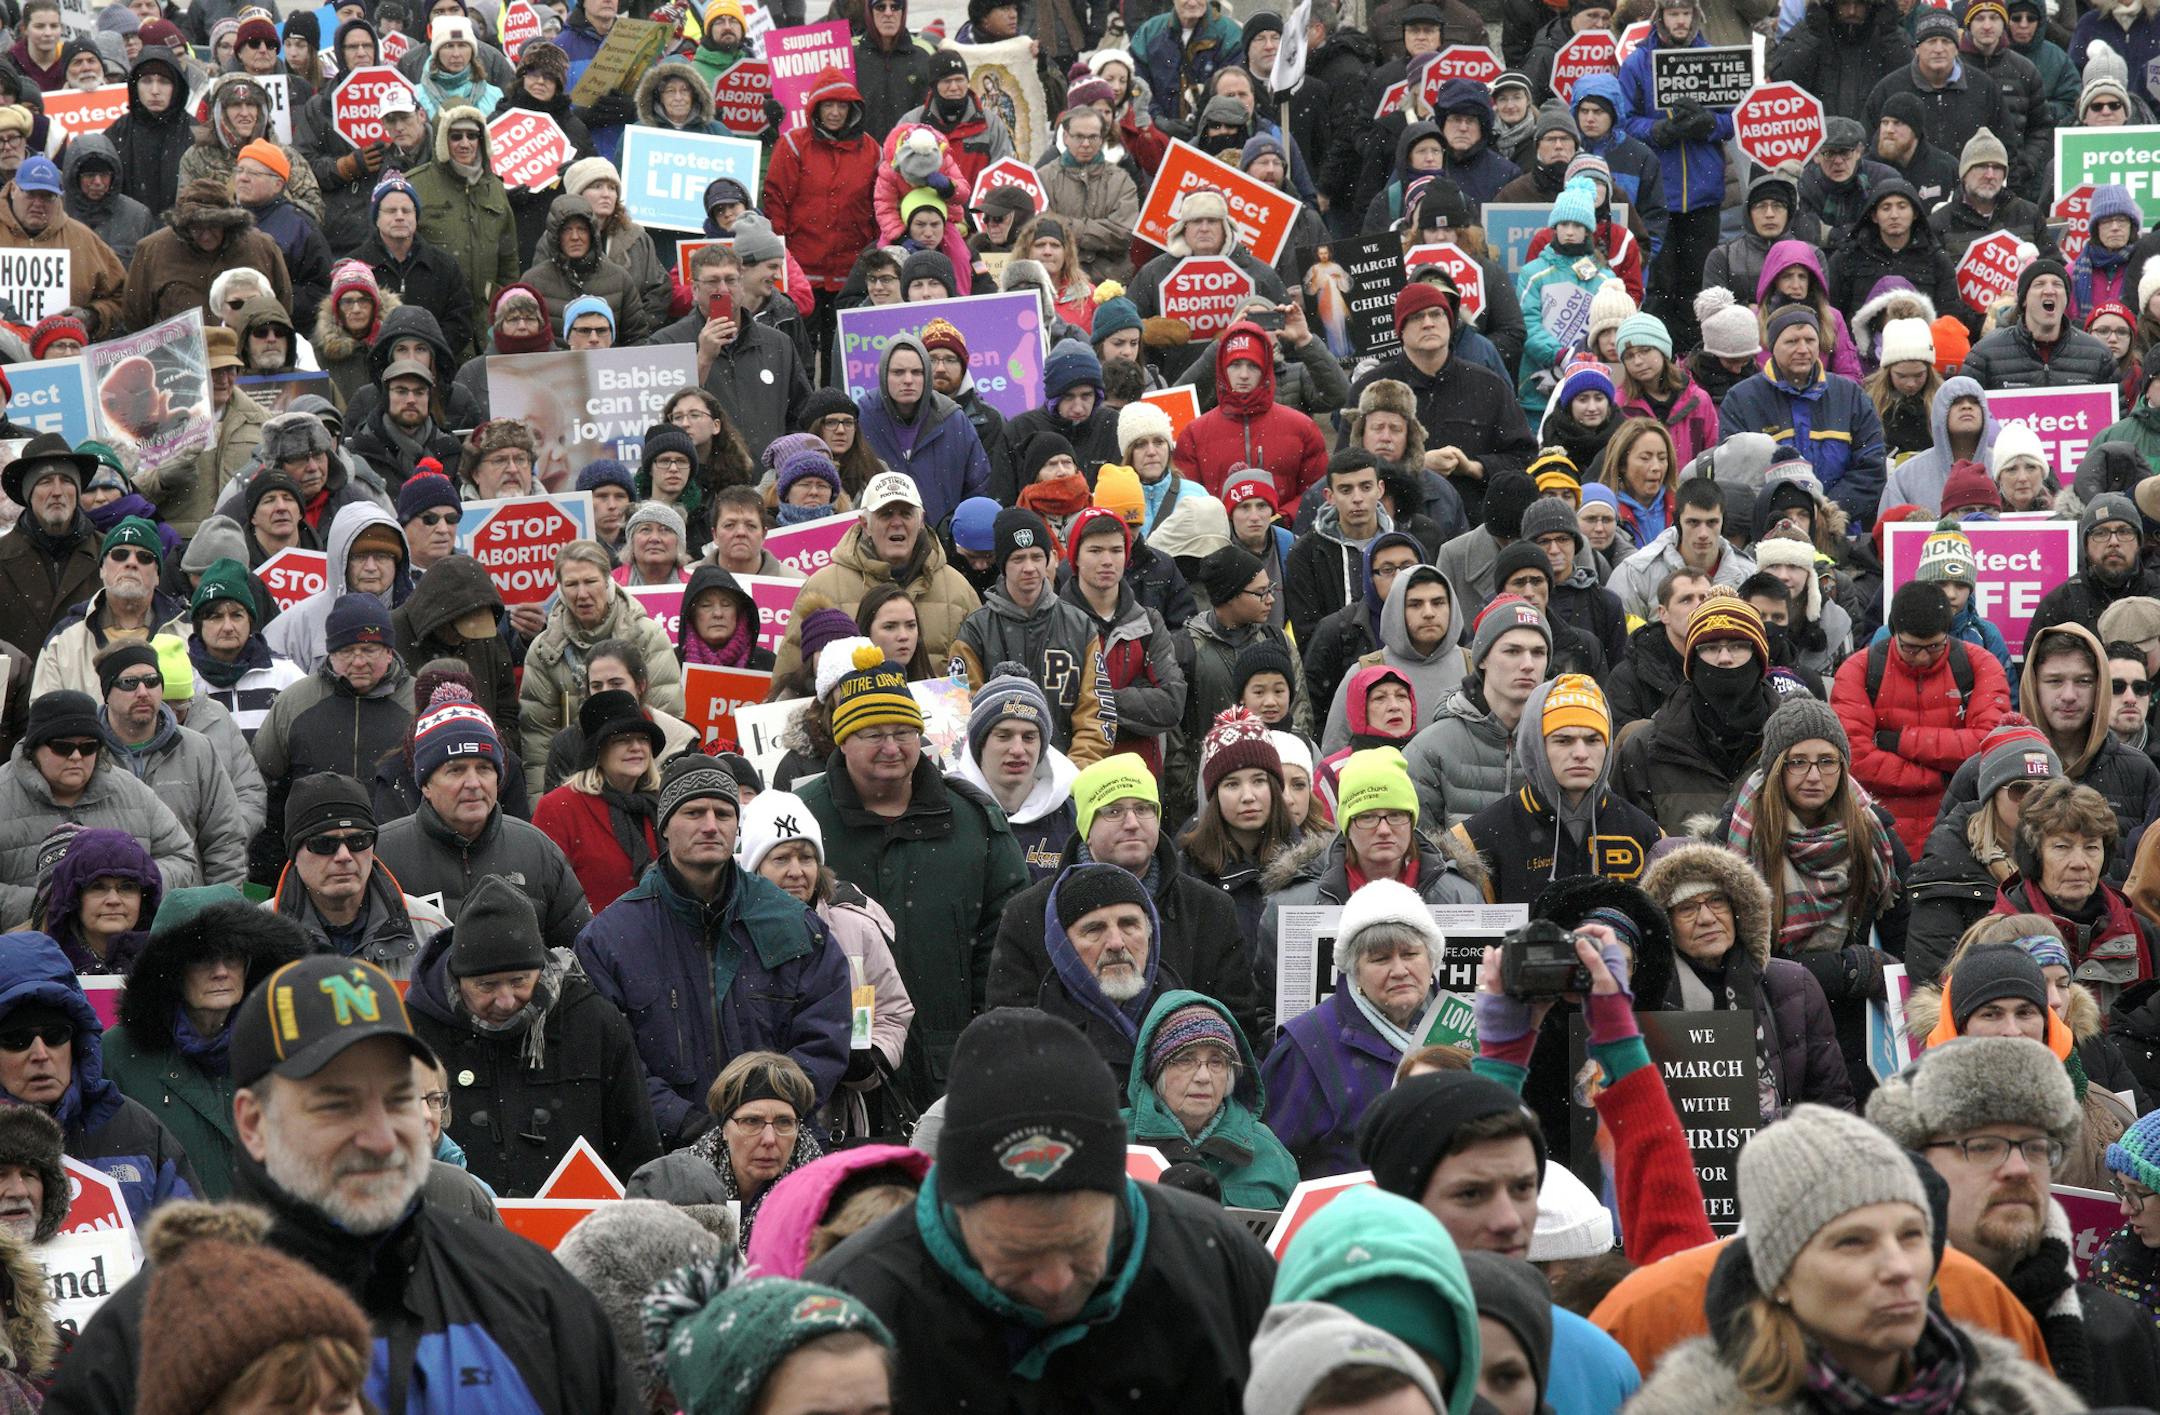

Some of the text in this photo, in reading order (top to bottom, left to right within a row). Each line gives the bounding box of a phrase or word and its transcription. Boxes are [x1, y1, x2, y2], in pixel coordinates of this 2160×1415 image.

[507, 12, 531, 26] STOP
[507, 43, 523, 57] NO
[783, 30, 833, 51] support
[772, 47, 850, 78] WOMEN!
[1568, 46, 1614, 61] STOP
[1438, 60, 1494, 78] STOP
[1662, 60, 1746, 77] I AM THE
[1659, 70, 1752, 91] PRO-LIFE
[716, 91, 767, 105] ABORTI
[1748, 97, 1805, 118] STOP
[340, 105, 382, 120] ABOR
[352, 123, 384, 139] NO
[491, 116, 537, 155] STOP
[1742, 117, 1818, 139] ABORTION
[495, 126, 559, 178] ABORTION
[1755, 136, 1809, 158] NOW
[512, 149, 561, 184] NOW
[649, 150, 735, 174] protect
[646, 161, 712, 202] LIF
[992, 171, 1037, 197] STOP
[1362, 243, 1379, 255] WE
[1982, 241, 2019, 273] STO
[1350, 256, 1399, 276] MARCH
[1176, 272, 1238, 291] STOP
[1361, 278, 1391, 291] WITH
[1350, 290, 1400, 313] CHRIS
[1962, 280, 1996, 307] NO
[1371, 314, 1394, 326] FOR
[1370, 330, 1399, 345] LIFE
[1378, 351, 1388, 361] IN
[599, 366, 687, 391] Babies
[586, 390, 634, 416] can
[572, 417, 611, 445] joy
[617, 440, 642, 461] in
[875, 479, 888, 492] OLD
[880, 491, 909, 499] FOOTBALL
[489, 515, 563, 541] STOP
[477, 543, 563, 566] ABORTIO
[268, 567, 326, 595] STO
[490, 568, 559, 591] NOW
[1517, 613, 1539, 625] LIFE
[840, 674, 876, 700] NOTRE
[447, 742, 493, 755] USA
[2026, 763, 2050, 775] LIFE
[773, 814, 801, 838] NY
[1688, 1029, 1715, 1044] WE
[1664, 1060, 1744, 1079] MARCH
[1681, 1097, 1730, 1113] WITH
[1685, 1127, 1756, 1151] HRIST
[1702, 1198, 1735, 1216] IFE
